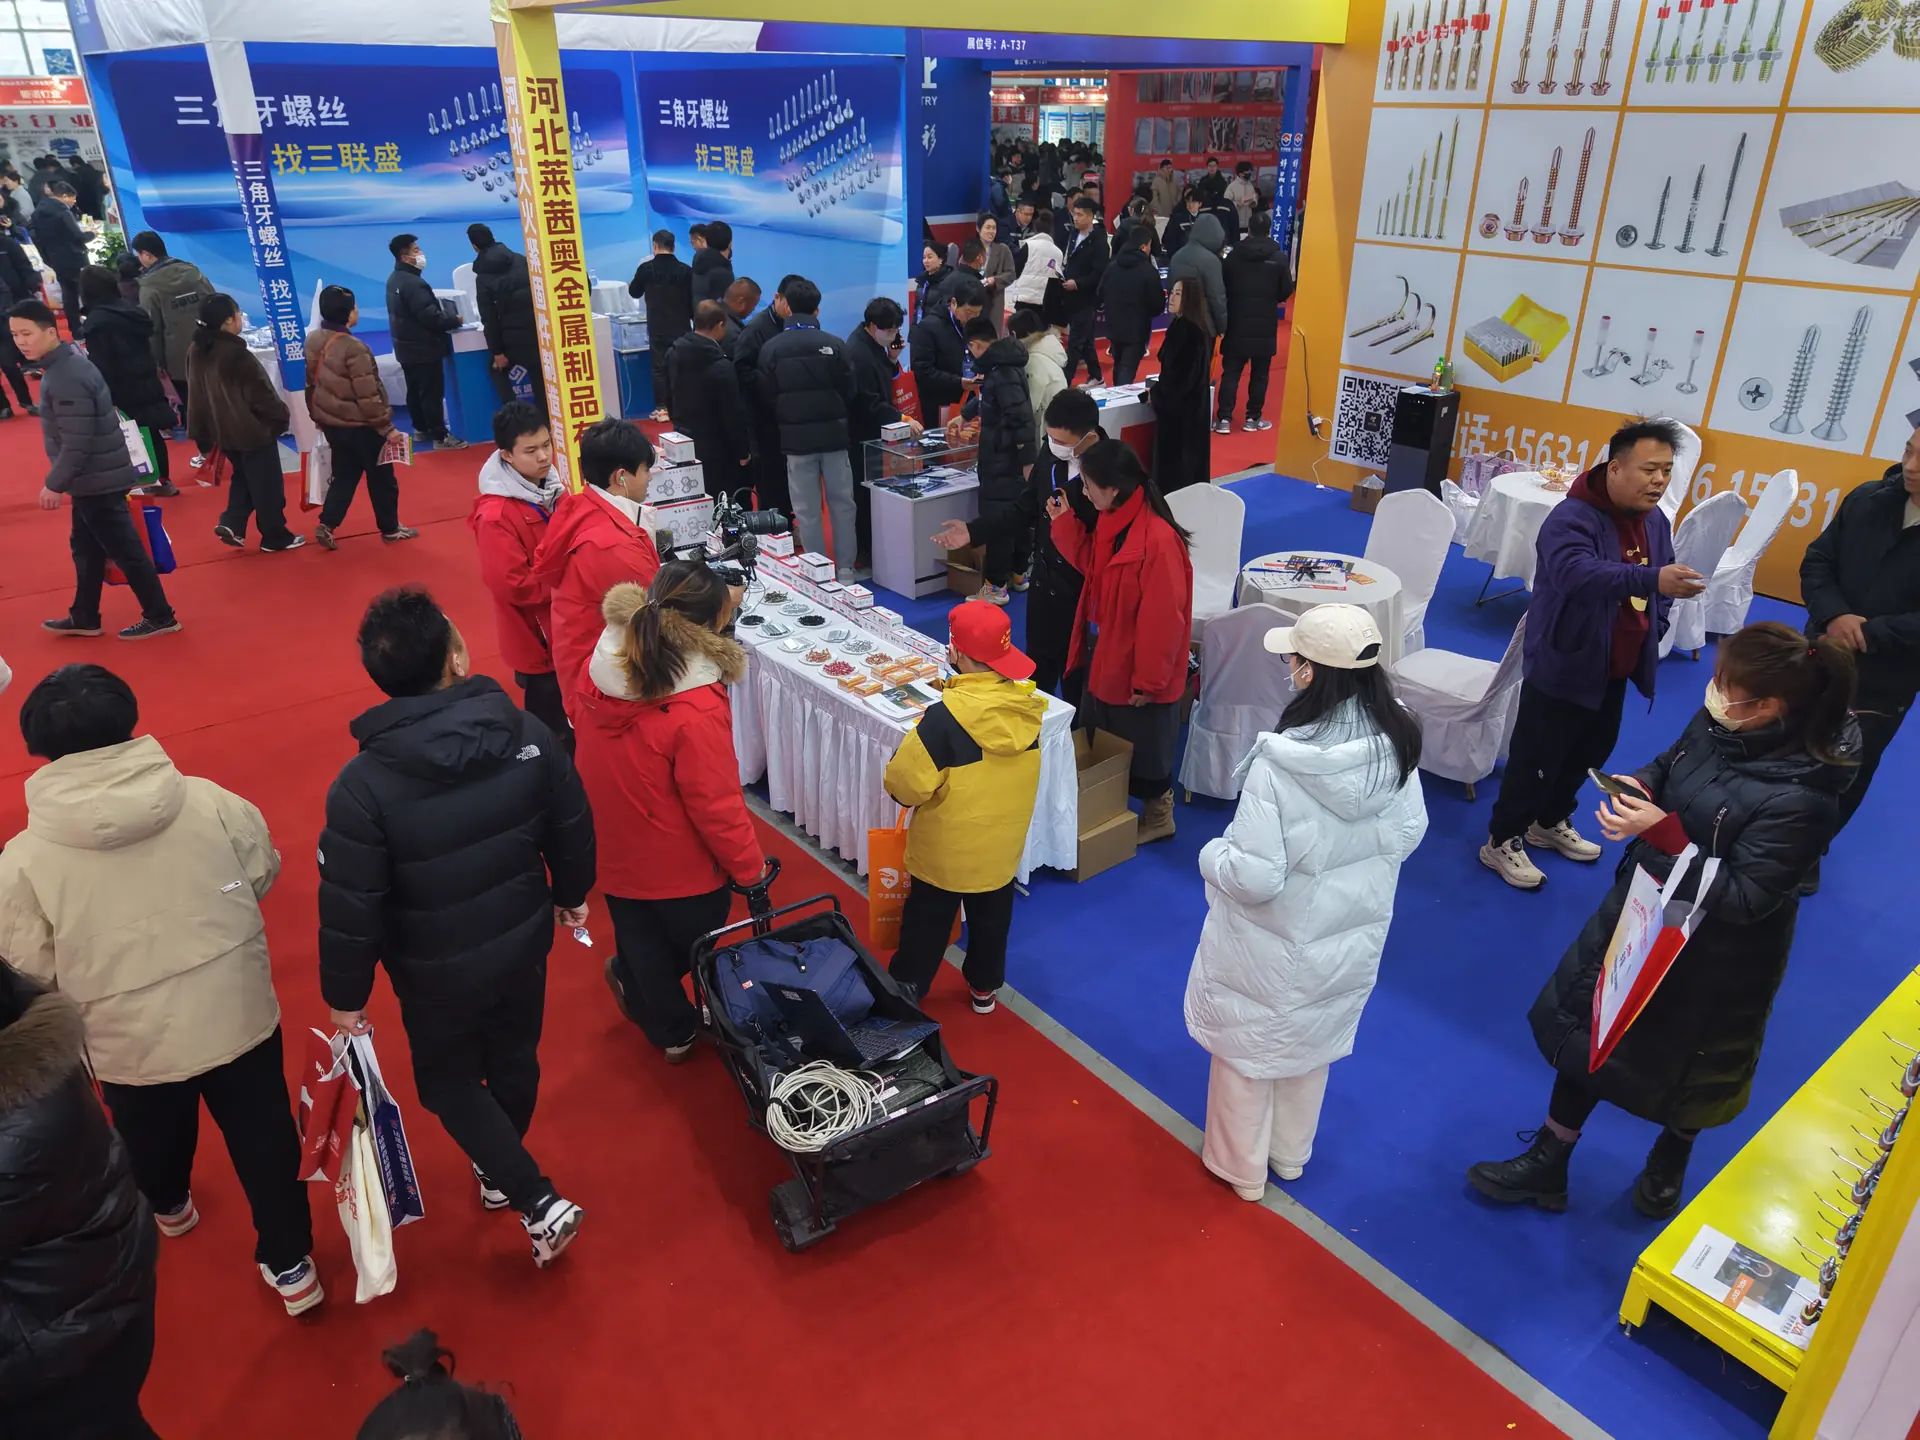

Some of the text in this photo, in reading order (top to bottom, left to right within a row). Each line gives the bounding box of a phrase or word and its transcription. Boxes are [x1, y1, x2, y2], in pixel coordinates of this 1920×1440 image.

[1000, 39, 1026, 51] A-T37
[658, 98, 731, 130] 三角牙螺丝
[991, 106, 1034, 123] 弹性销
[271, 142, 403, 175] 找三联盛
[695, 143, 755, 177] 找三联盛
[243, 160, 305, 361] 三角牙螺丝 找三联盛
